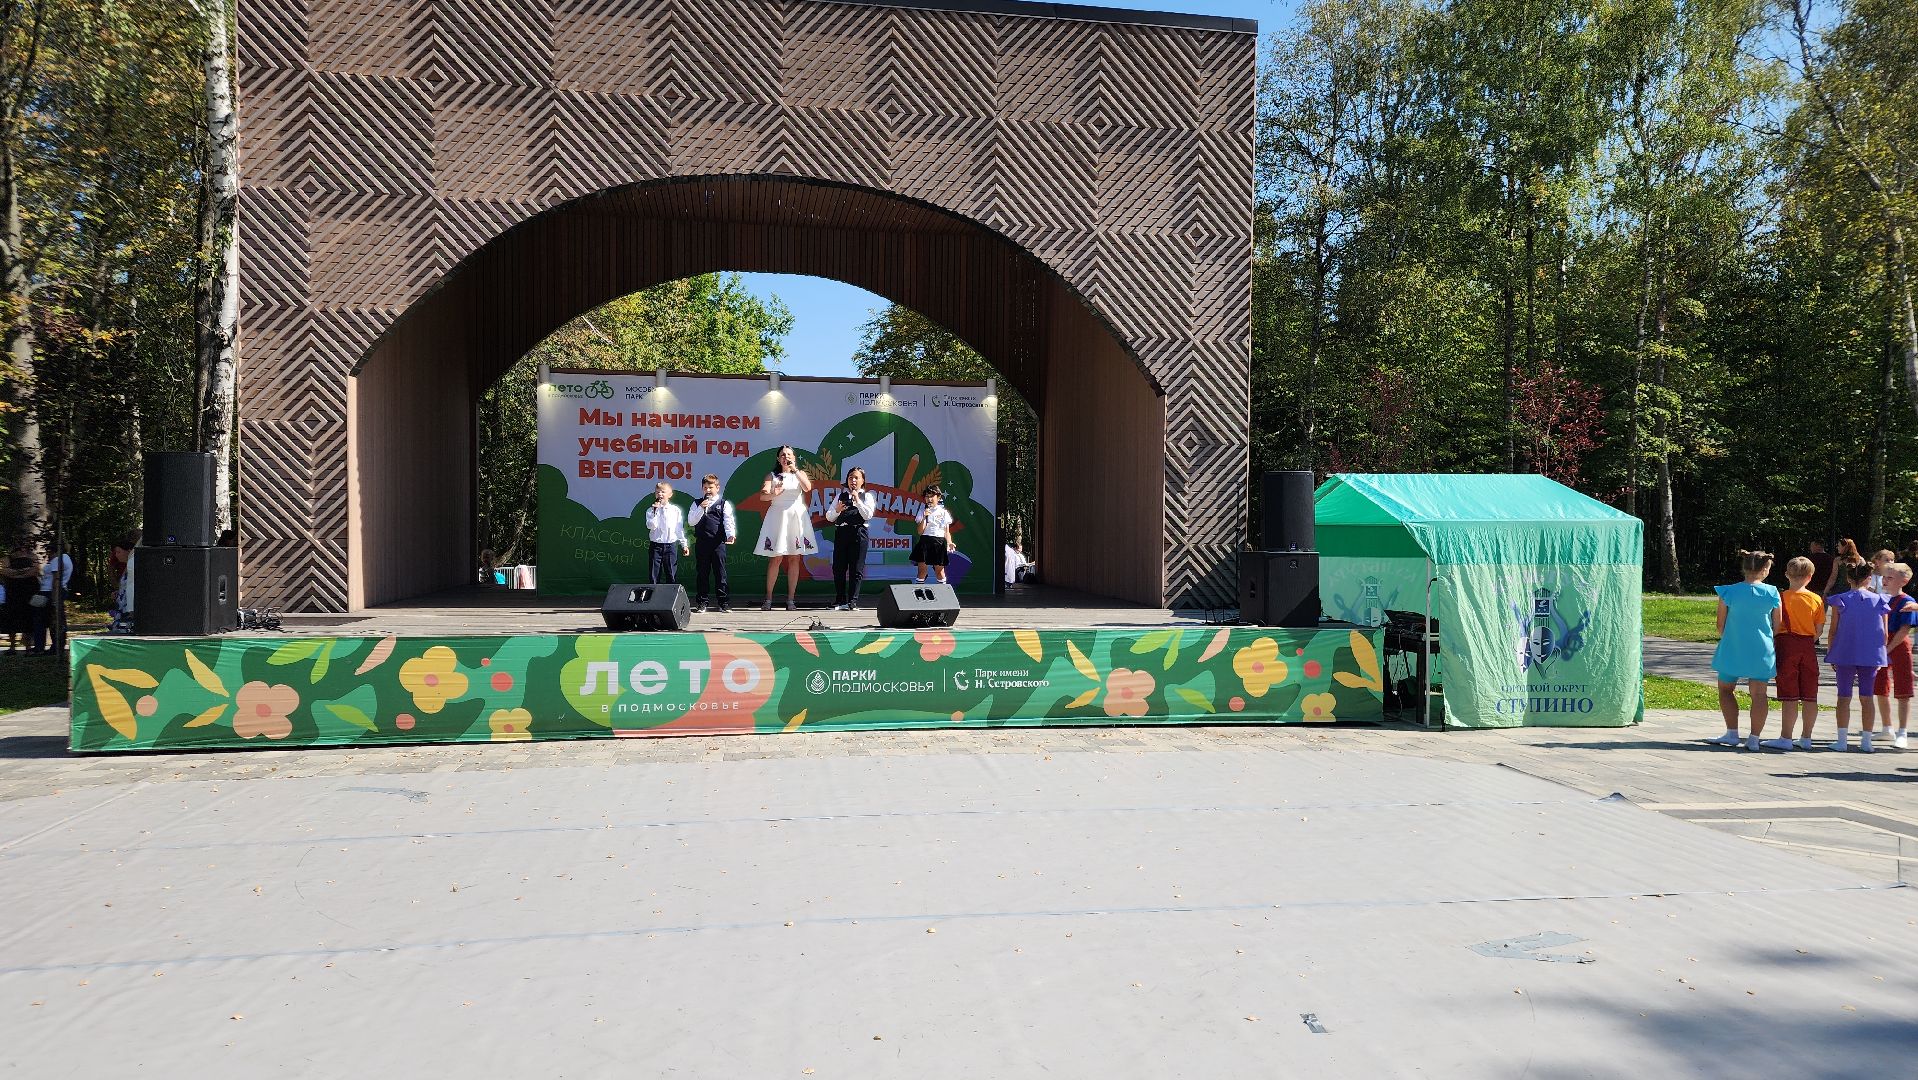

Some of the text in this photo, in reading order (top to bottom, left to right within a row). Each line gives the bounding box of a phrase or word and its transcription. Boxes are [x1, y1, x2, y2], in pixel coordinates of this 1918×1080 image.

[578, 407, 760, 430] Мы начинаем
[578, 433, 750, 457] учебный год
[578, 460, 692, 480] ВЕСЕЛО!
[869, 538, 910, 549] ТЯБРЯ
[832, 670, 877, 681] ПАРКИ
[975, 668, 1029, 679] Парк имени
[832, 682, 934, 693] ПОДМОСКОВЬЯ
[975, 679, 986, 689] Н.
[1553, 684, 1588, 693] ОКРУГ
[601, 701, 739, 713] В ПОДМОСКОВЬЕ
[1496, 697, 1594, 714] СТУПИНО
